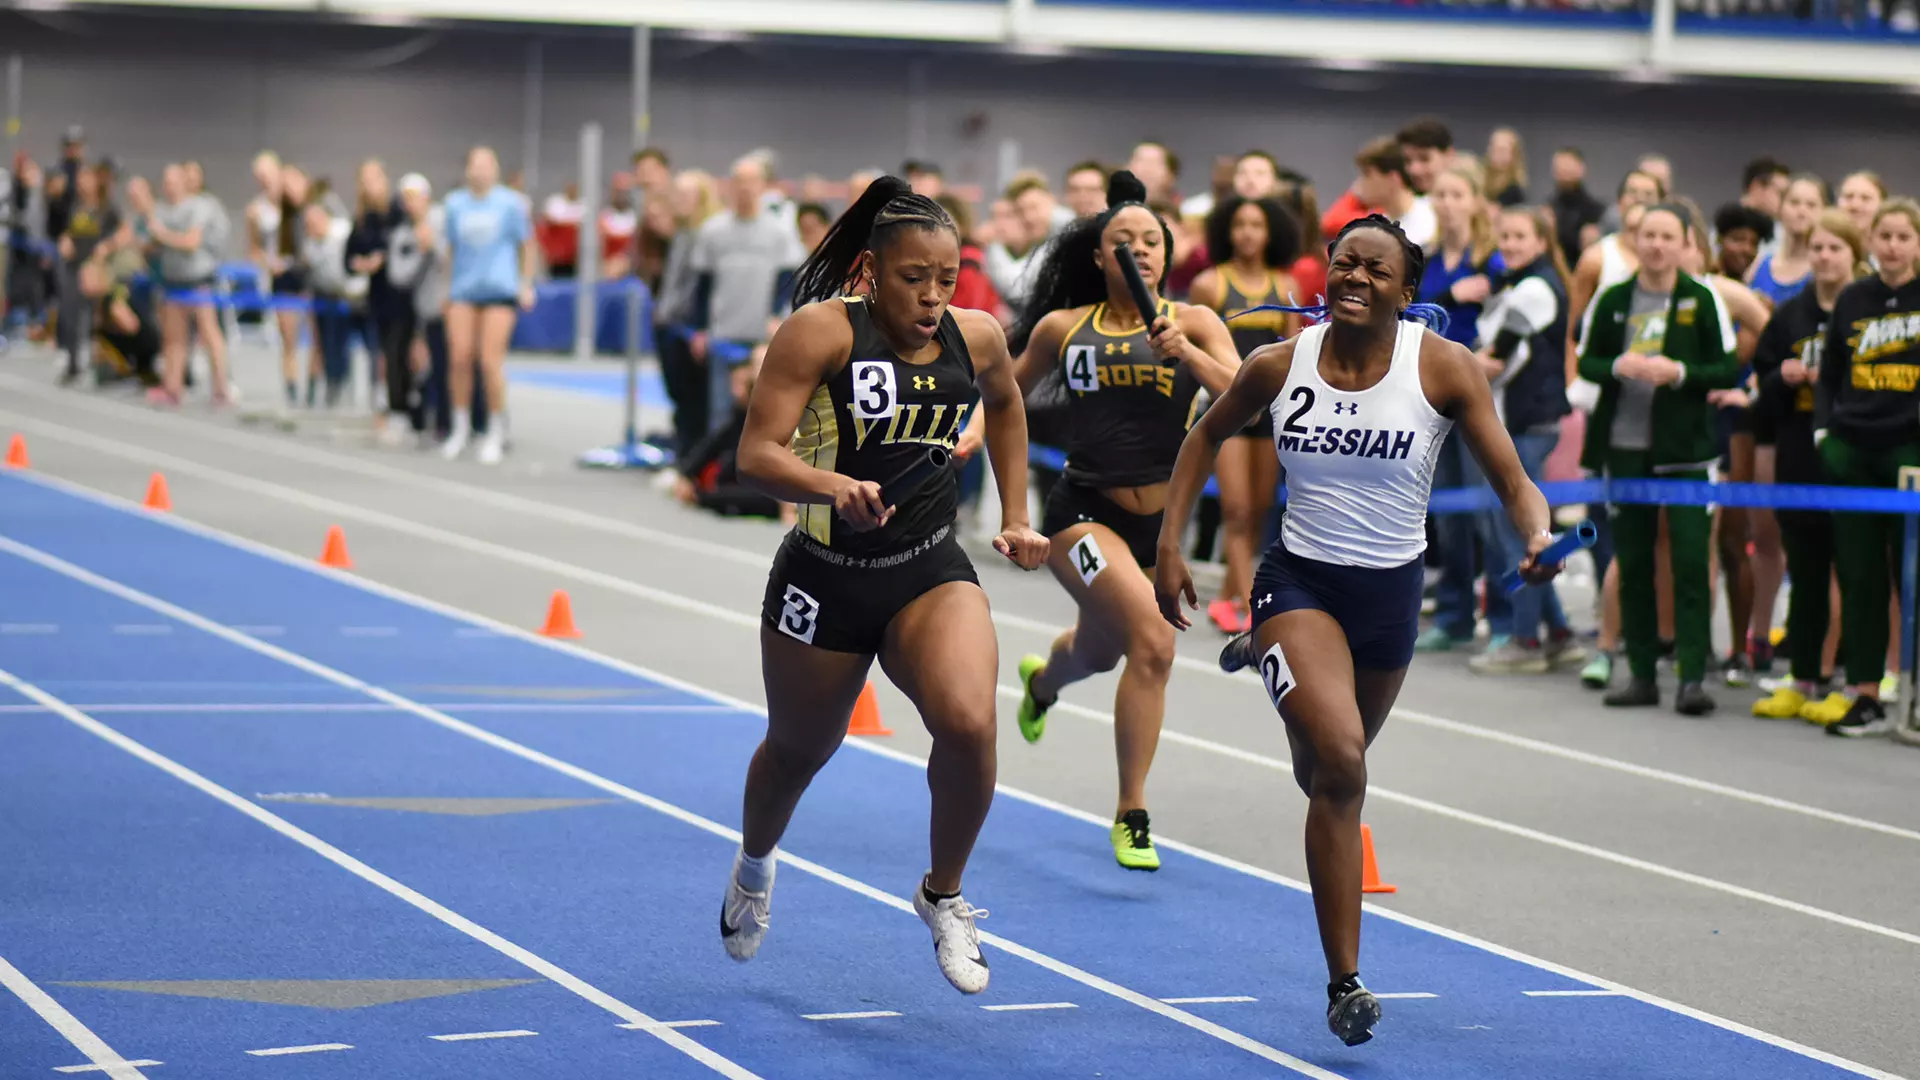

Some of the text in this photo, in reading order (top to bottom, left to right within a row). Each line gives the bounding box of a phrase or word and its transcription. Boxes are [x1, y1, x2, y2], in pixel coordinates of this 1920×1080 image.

[1071, 349, 1092, 388] 4
[1078, 364, 1176, 398] ROFS
[859, 365, 889, 415] 3
[1283, 386, 1315, 435] 2
[1278, 426, 1415, 460] MESSIAH
[803, 540, 845, 566] ARMOUR
[869, 549, 913, 569] ARMOUR
[1078, 541, 1099, 576] 4
[785, 592, 812, 636] 3
[1263, 653, 1290, 703] 2
